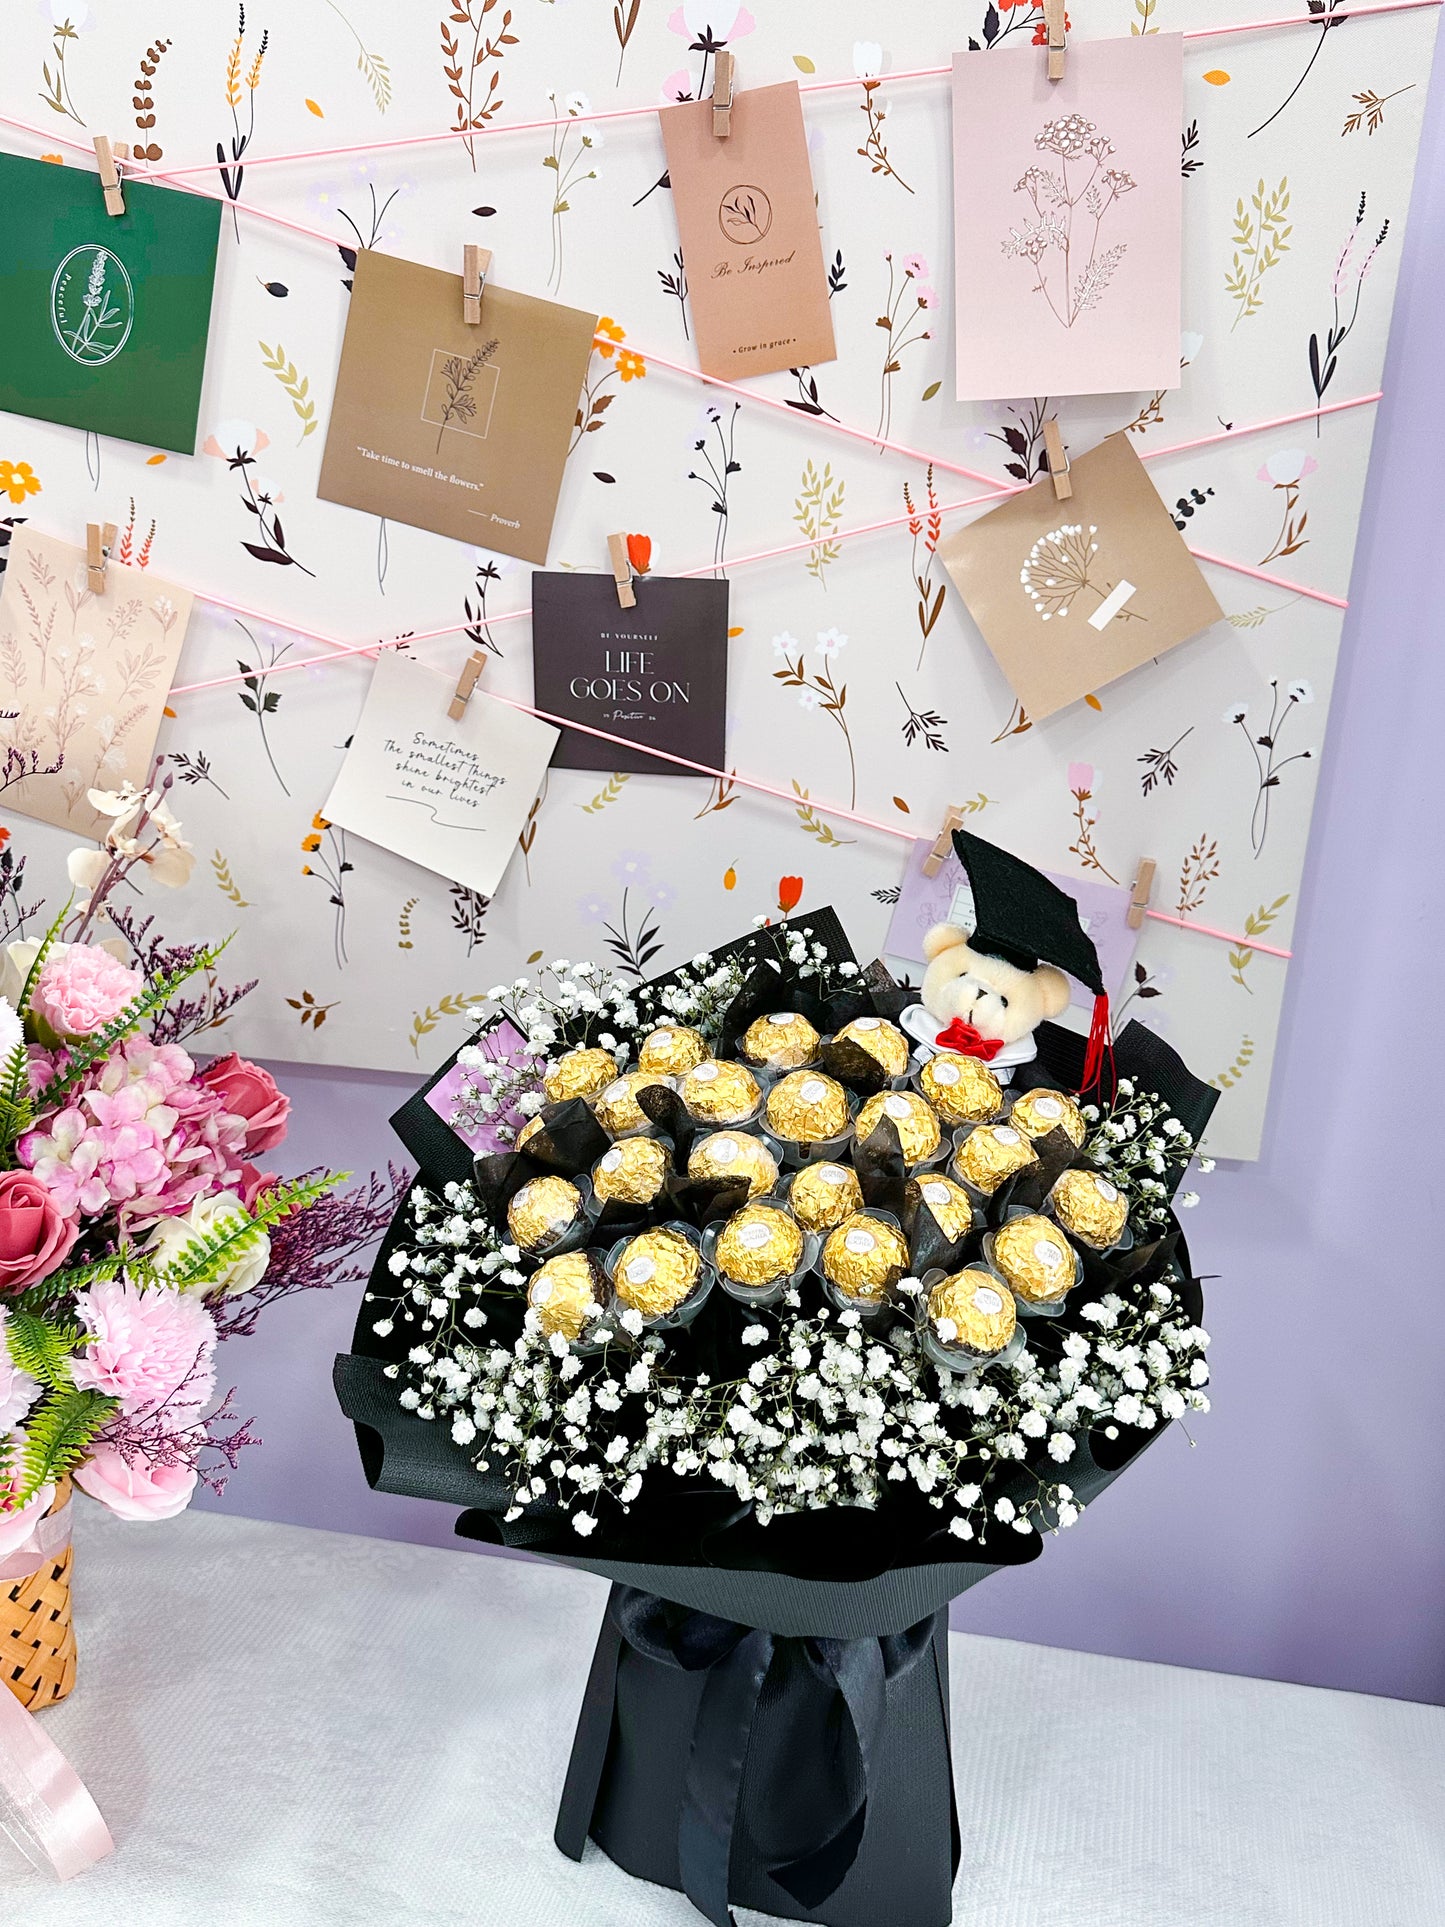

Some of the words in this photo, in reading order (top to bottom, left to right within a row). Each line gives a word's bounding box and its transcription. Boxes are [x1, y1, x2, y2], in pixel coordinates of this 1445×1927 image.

[711, 261, 732, 279] Be
[737, 250, 796, 274] Inspired
[58, 273, 72, 324] Peaceful
[738, 345, 758, 354] Grow
[769, 339, 791, 349] grace
[381, 455, 401, 467] time
[401, 461, 411, 470] to
[411, 467, 434, 477] smell
[434, 471, 448, 481] the
[490, 513, 521, 530] Proverb
[605, 650, 655, 674] LIFE
[570, 677, 643, 702] GOES
[649, 681, 690, 703] ON
[412, 732, 480, 761] Sometimes
[408, 750, 467, 773] smallest
[395, 760, 430, 778] shine
[435, 769, 496, 797] brightest
[401, 779, 415, 789] in
[420, 785, 443, 796] our
[449, 788, 480, 808] lives
